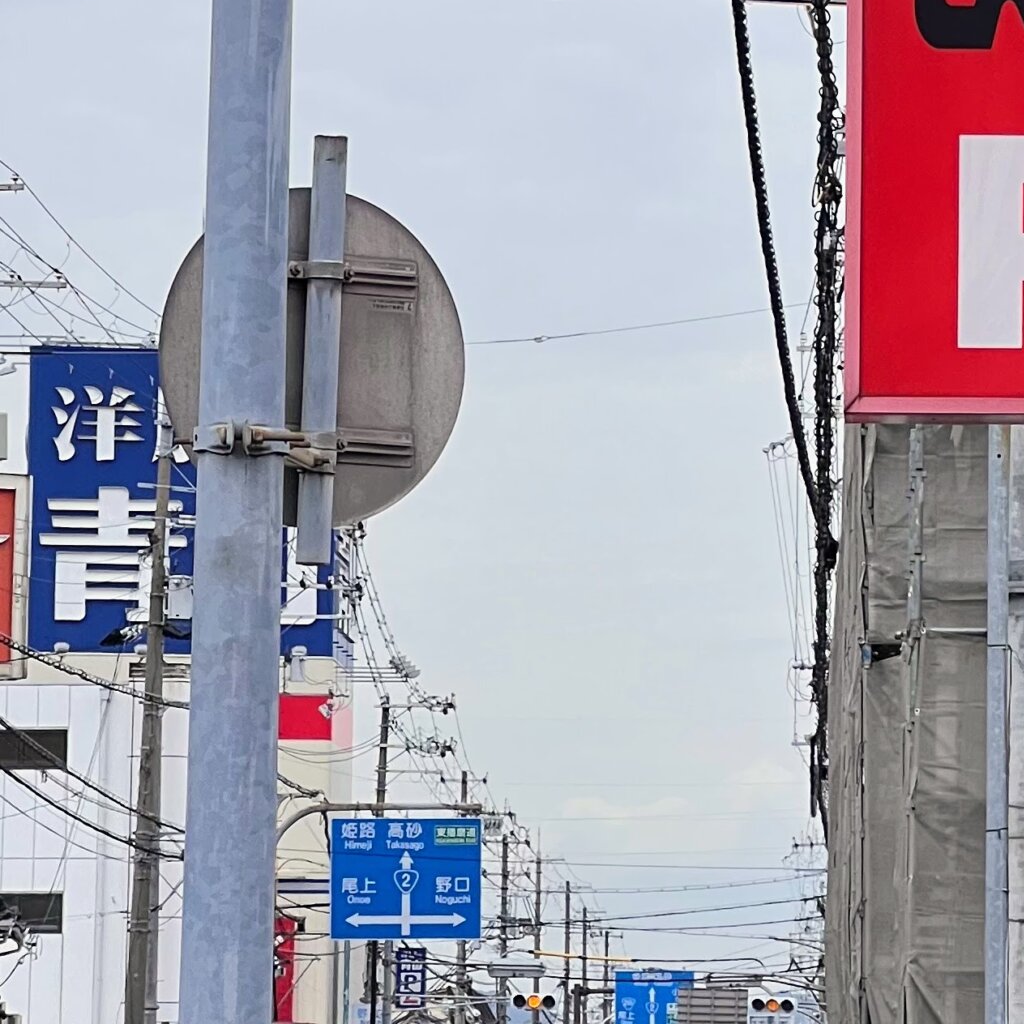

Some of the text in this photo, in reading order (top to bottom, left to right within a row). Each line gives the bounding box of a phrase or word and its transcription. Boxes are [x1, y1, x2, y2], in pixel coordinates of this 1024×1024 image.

[341, 822, 422, 839] 姫路 高砂
[344, 840, 372, 851] Himeji
[386, 840, 424, 851] Takasago
[342, 877, 376, 894] 尾上
[401, 873, 411, 888] 2
[435, 876, 469, 893] 野口
[435, 895, 471, 905] Noguchi
